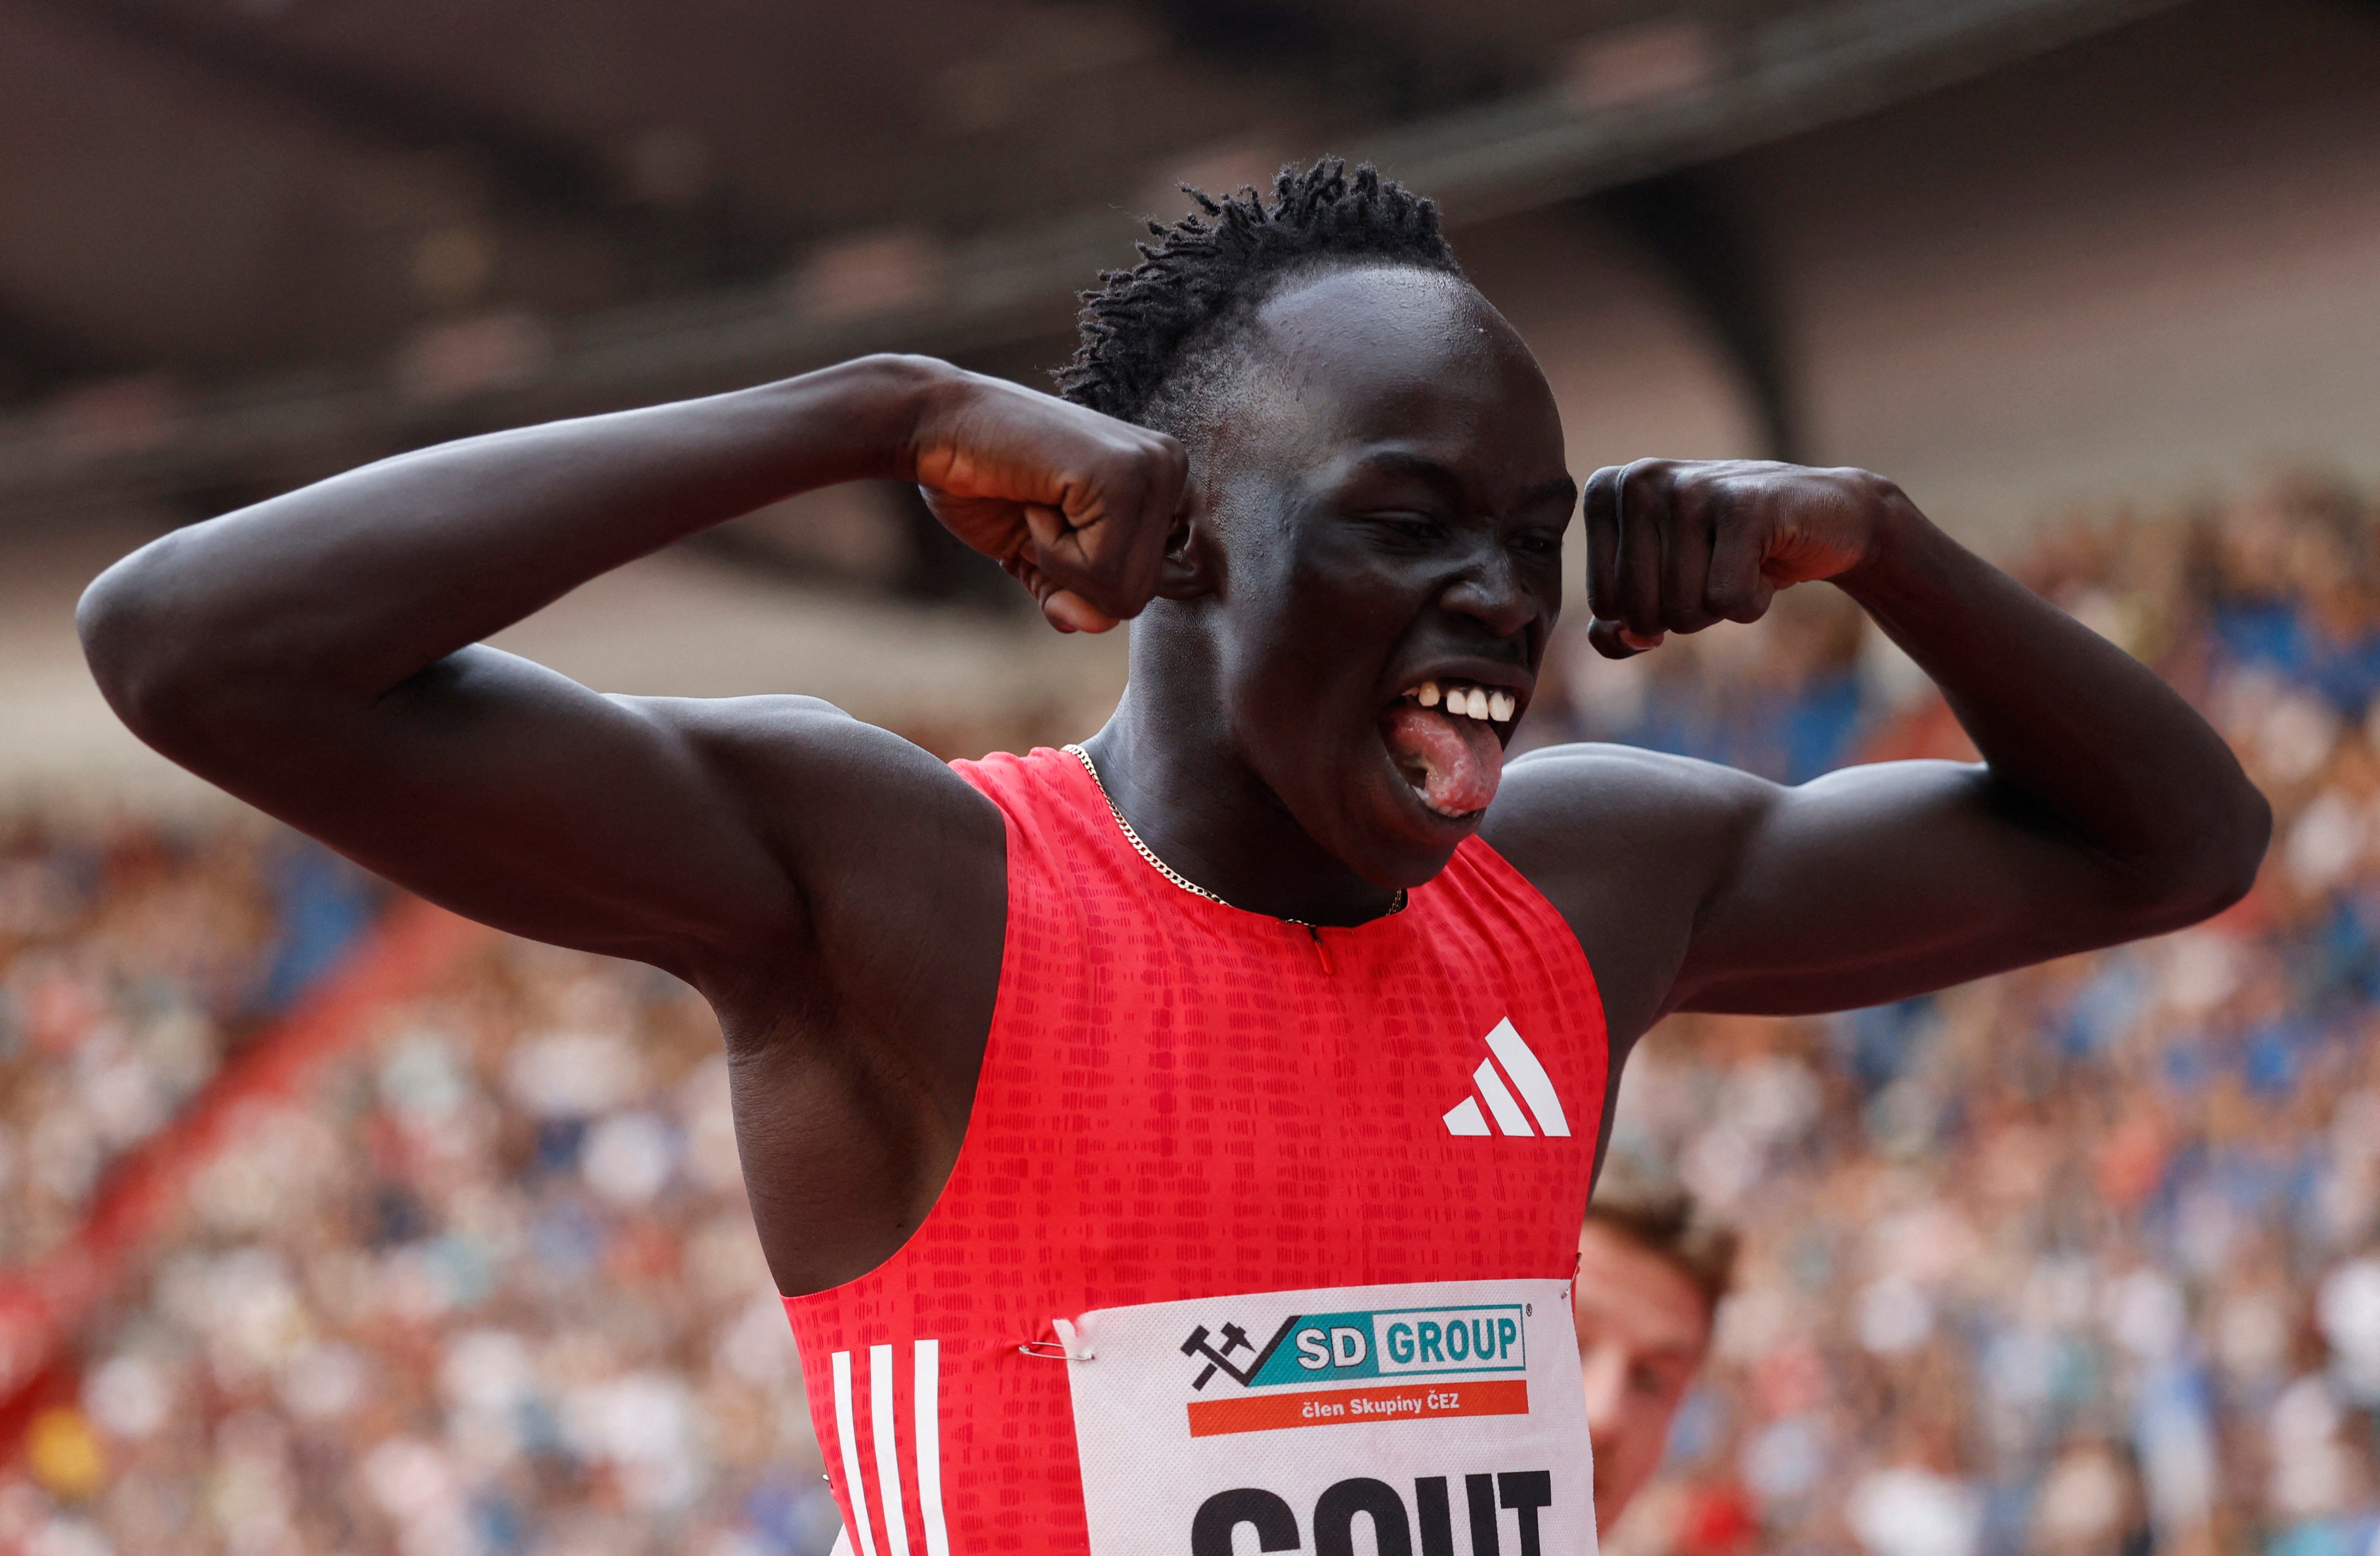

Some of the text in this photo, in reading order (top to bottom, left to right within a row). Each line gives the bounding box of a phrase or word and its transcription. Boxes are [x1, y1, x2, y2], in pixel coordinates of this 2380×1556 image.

[1295, 1318, 1517, 1370] SD GROUP
[1302, 1390, 1459, 1418] člen Skupiny ČEZ
